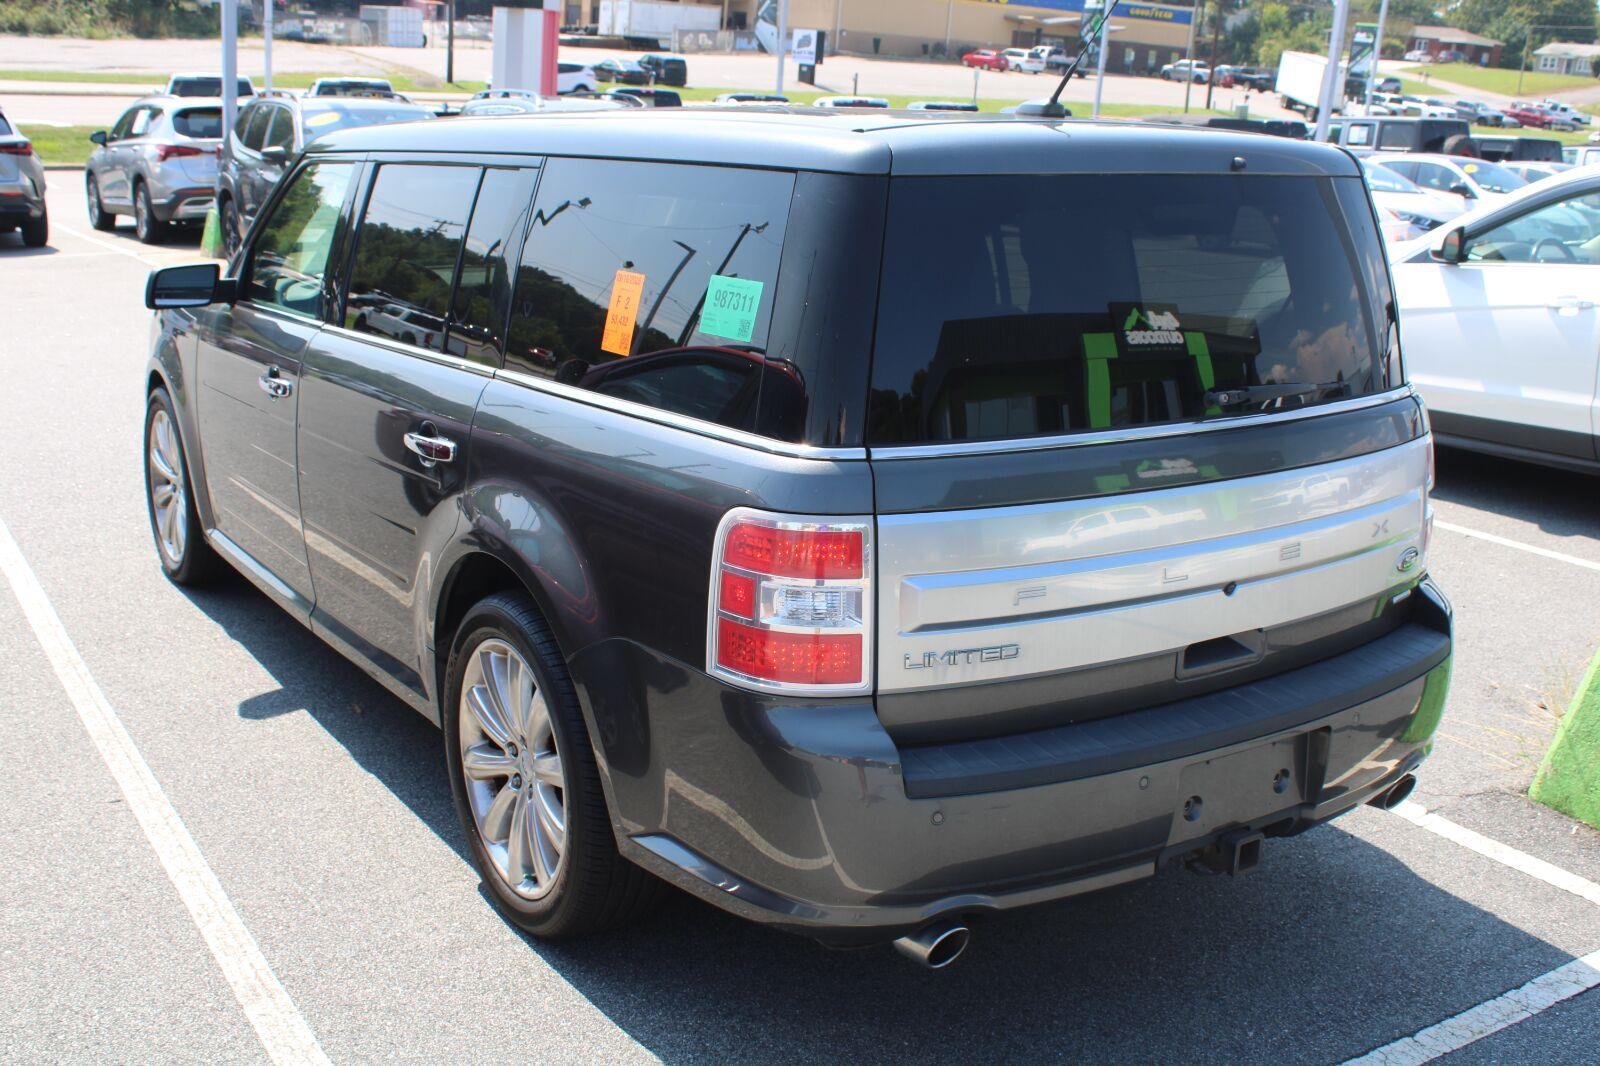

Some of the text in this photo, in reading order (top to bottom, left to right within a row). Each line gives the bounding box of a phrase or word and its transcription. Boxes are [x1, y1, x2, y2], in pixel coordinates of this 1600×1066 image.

[714, 288, 755, 313] 987311
[1013, 519, 1389, 606] FLEX
[904, 643, 1021, 670] LIMITED
